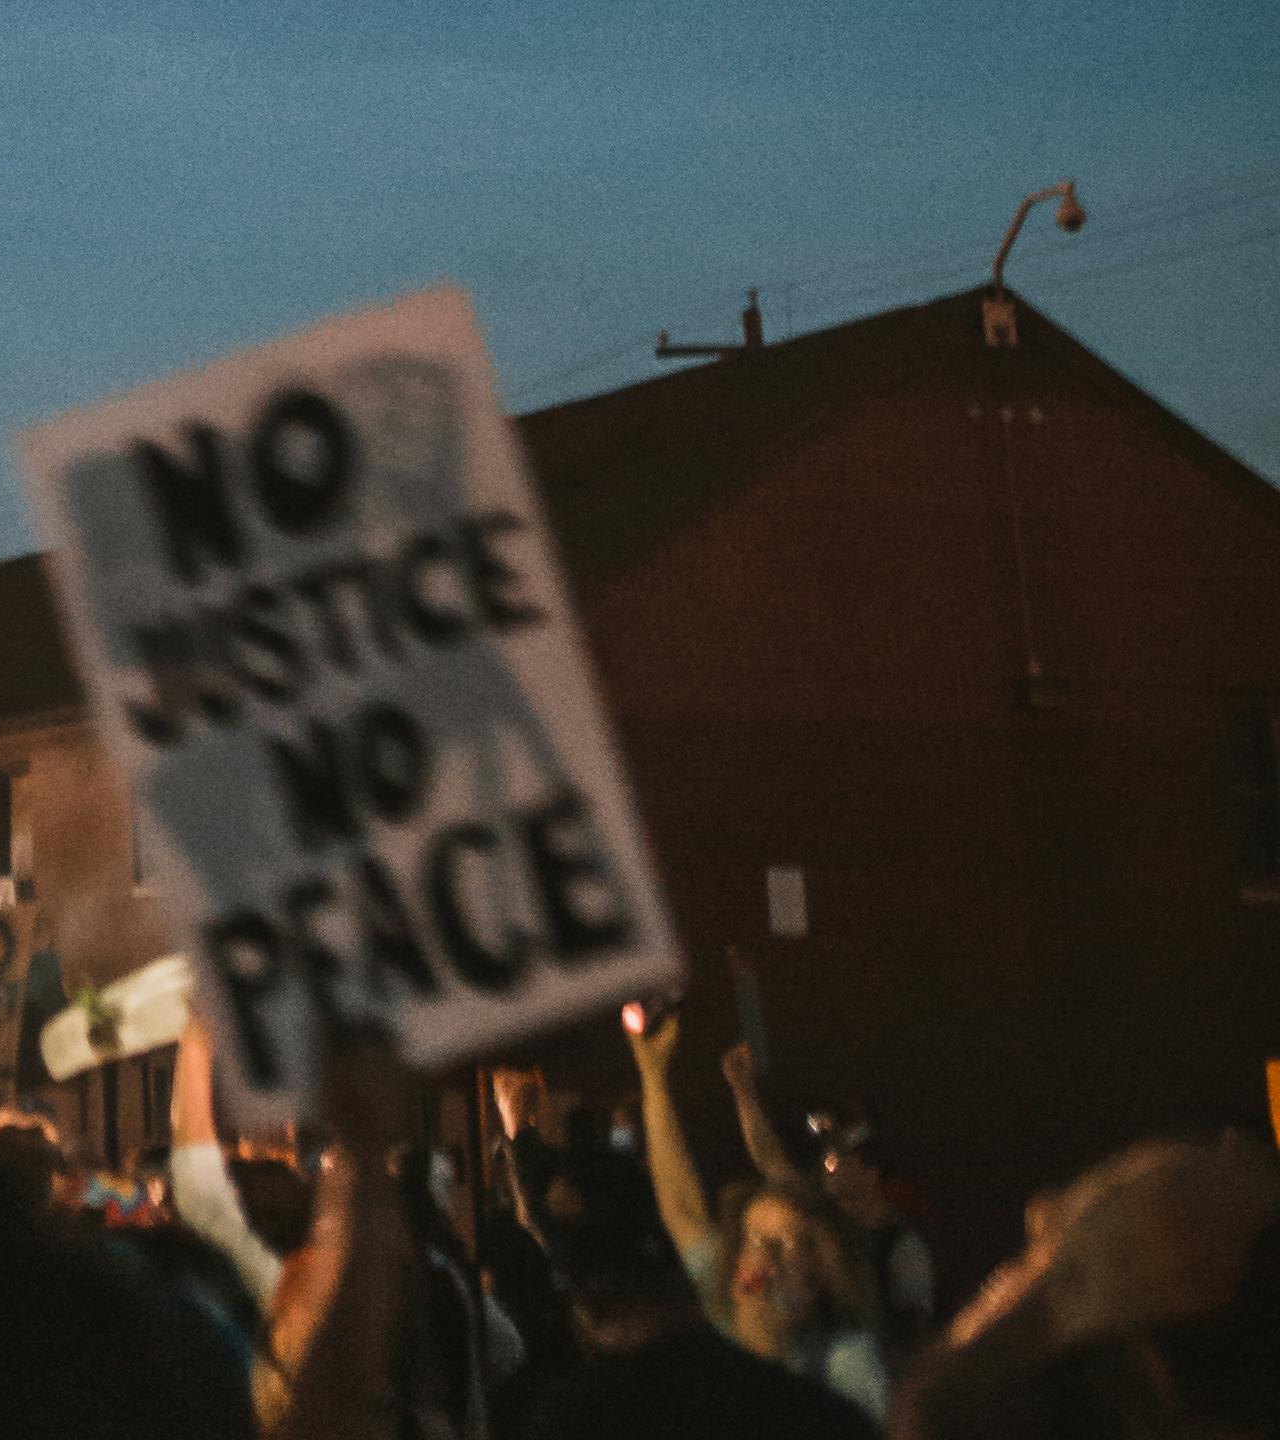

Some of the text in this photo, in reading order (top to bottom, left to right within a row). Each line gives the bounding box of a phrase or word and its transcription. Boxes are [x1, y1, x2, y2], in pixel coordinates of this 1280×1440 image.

[133, 386, 356, 584] NO
[269, 700, 433, 852] NO
[208, 792, 634, 1089] PEACE
